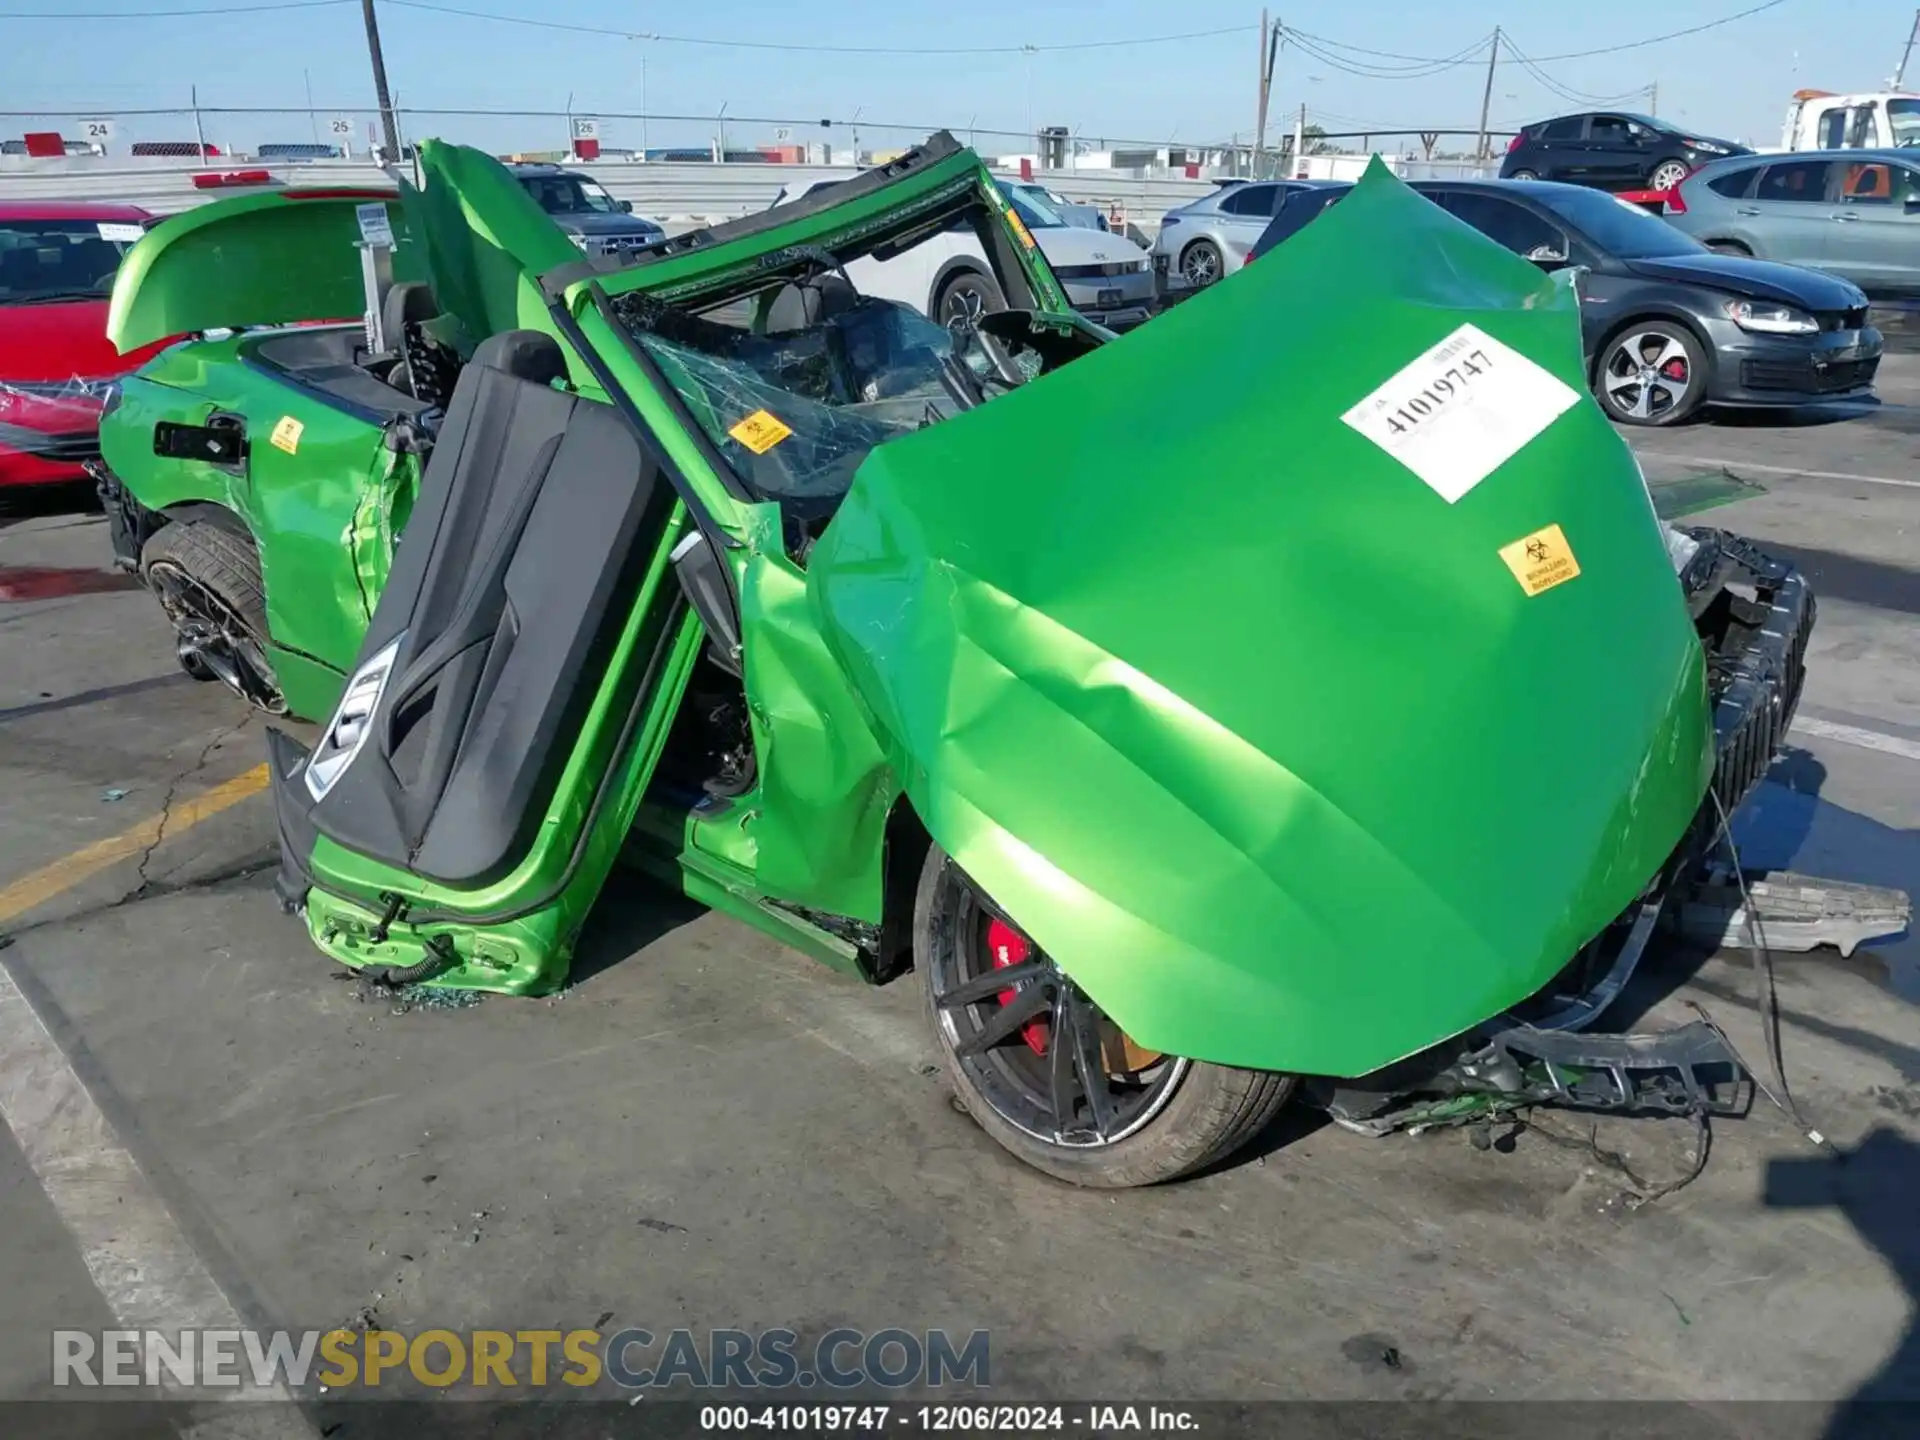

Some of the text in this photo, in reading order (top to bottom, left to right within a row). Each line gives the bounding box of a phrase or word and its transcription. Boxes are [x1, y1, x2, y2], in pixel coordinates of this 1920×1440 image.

[88, 124, 108, 137] 24
[332, 121, 349, 133] 25
[580, 122, 594, 134] 26
[1386, 349, 1493, 435] 41019747
